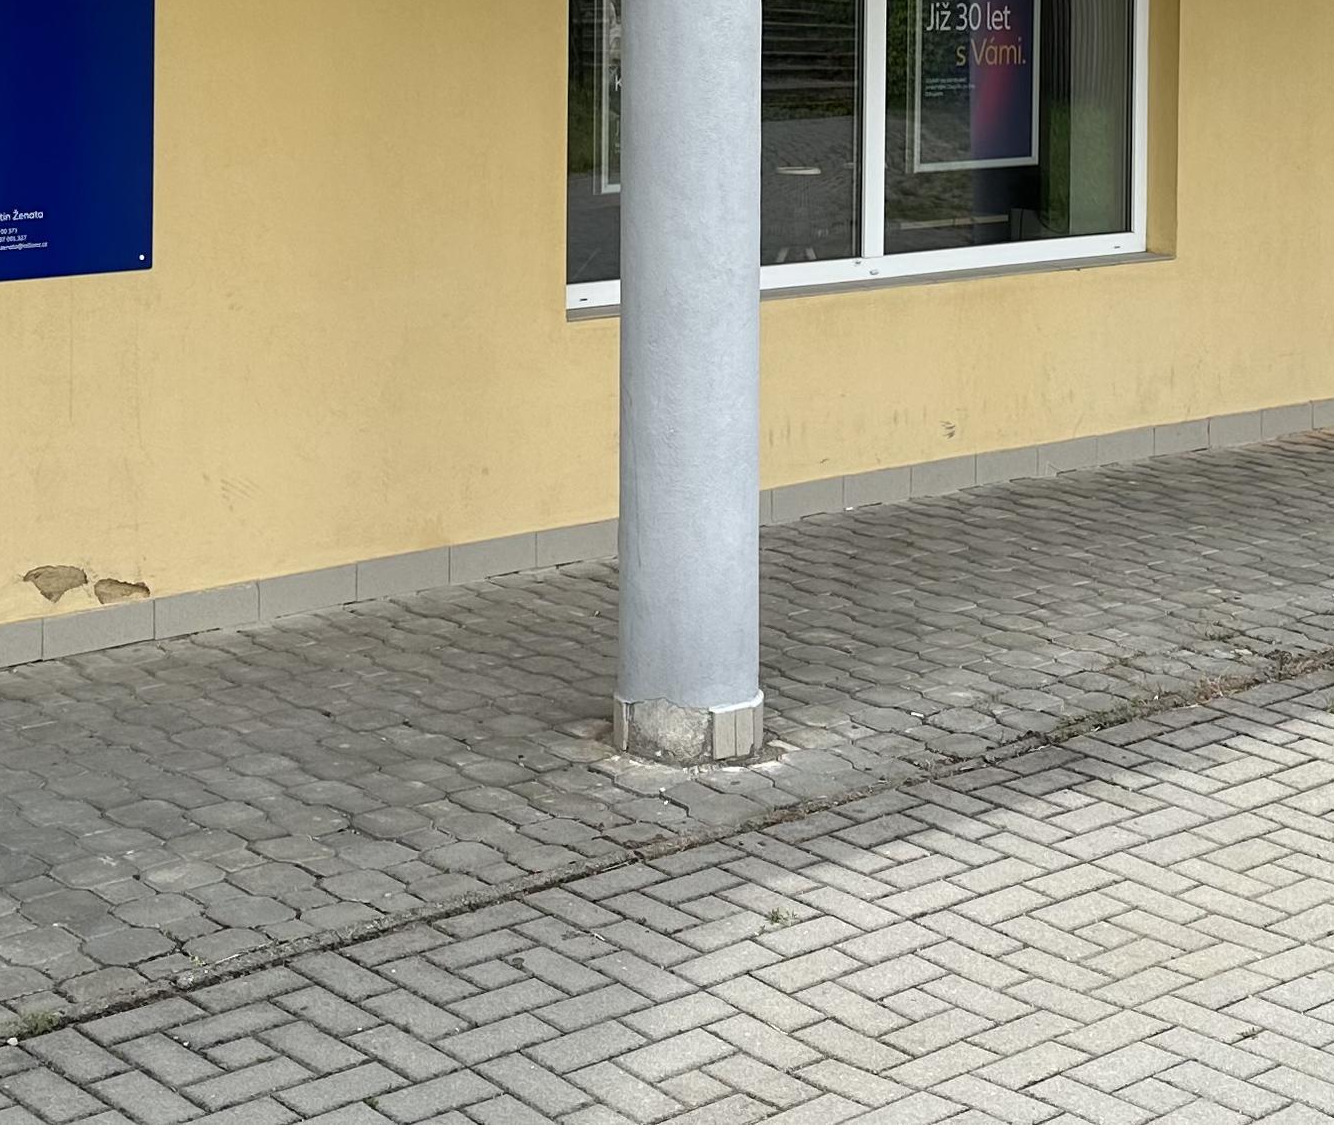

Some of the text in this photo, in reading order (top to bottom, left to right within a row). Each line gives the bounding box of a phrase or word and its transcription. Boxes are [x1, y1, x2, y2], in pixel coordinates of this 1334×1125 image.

[927, 1, 1011, 31] Již 30 let
[956, 36, 1026, 66] s Vámi.
[12, 209, 44, 221] Ženata
